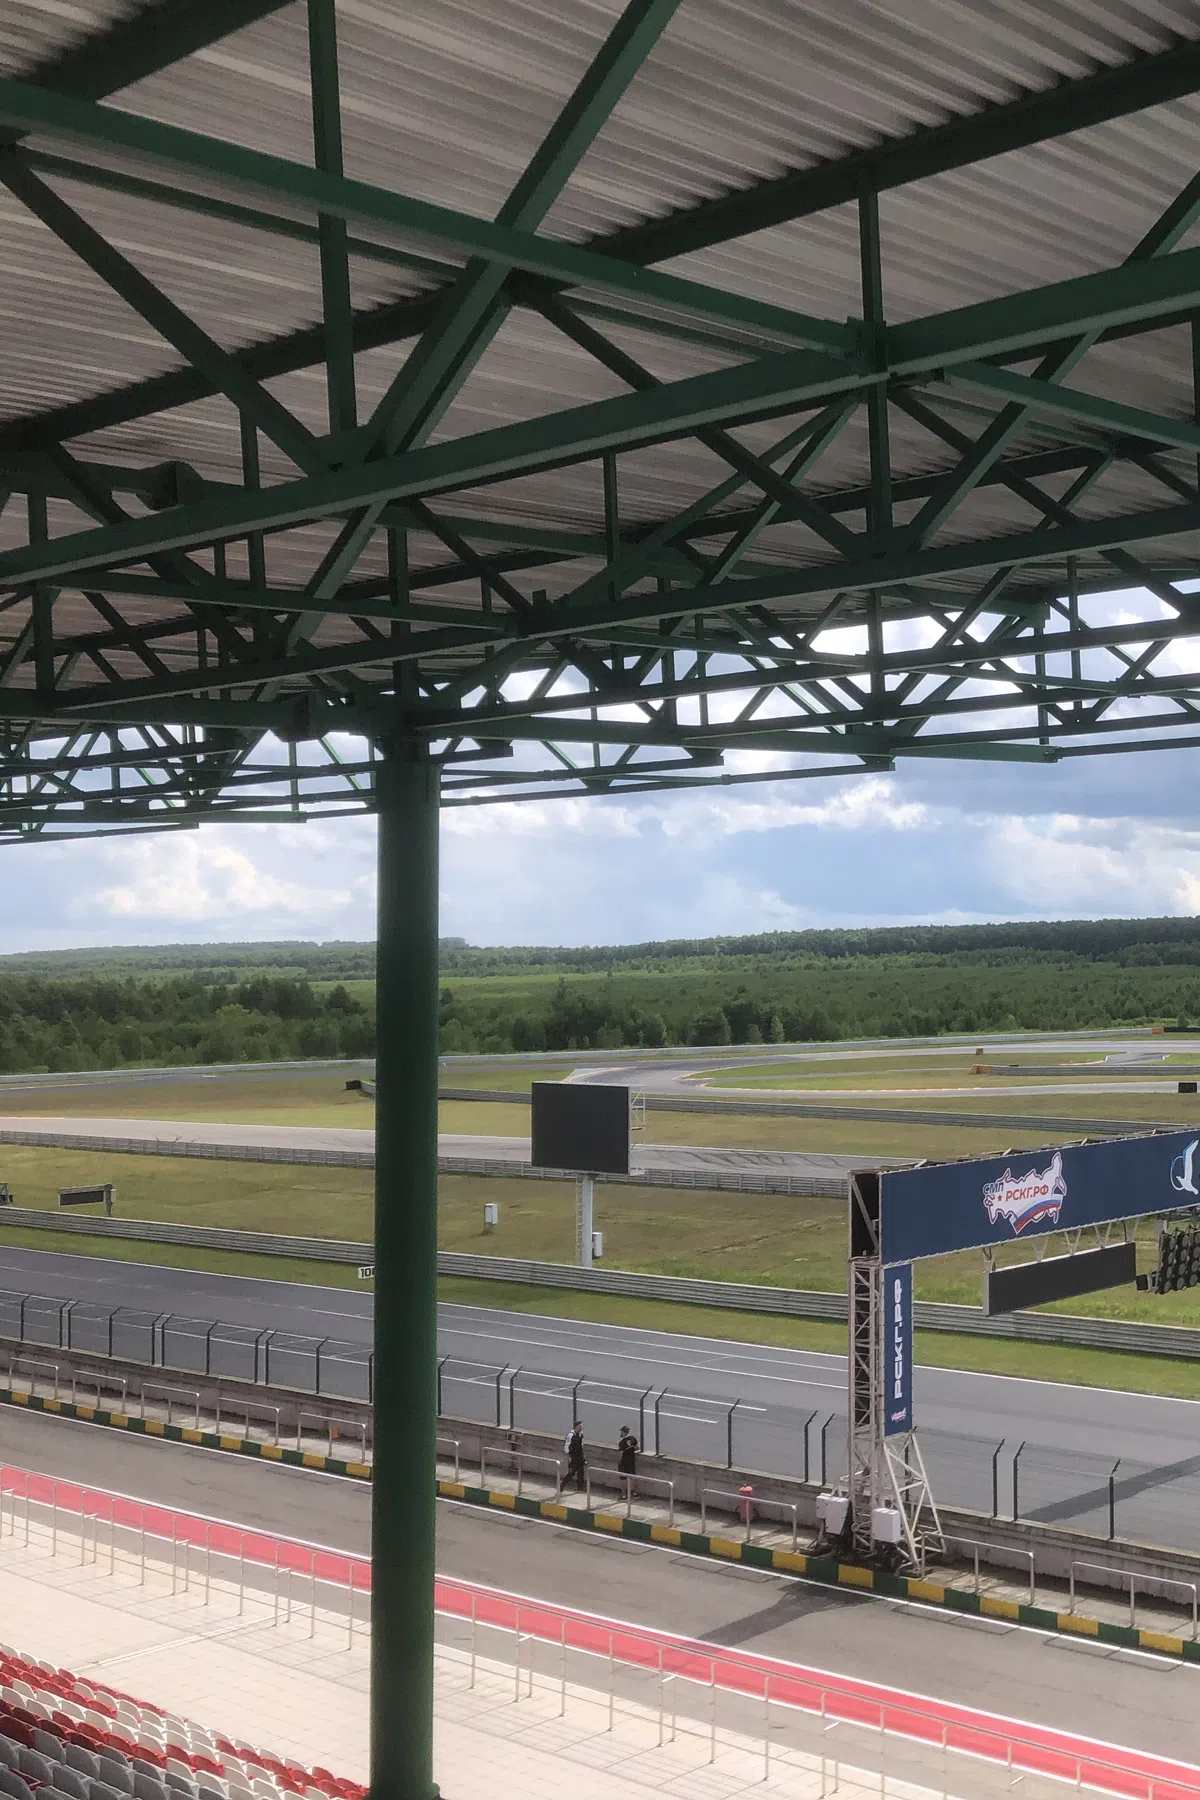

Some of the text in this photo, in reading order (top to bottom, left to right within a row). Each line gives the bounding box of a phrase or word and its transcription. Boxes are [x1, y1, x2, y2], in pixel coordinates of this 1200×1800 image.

[983, 1181, 1004, 1195] СМП
[1005, 1184, 1049, 1202] РСКГ.РФ
[894, 1278, 903, 1399] РСКГ.РФ
